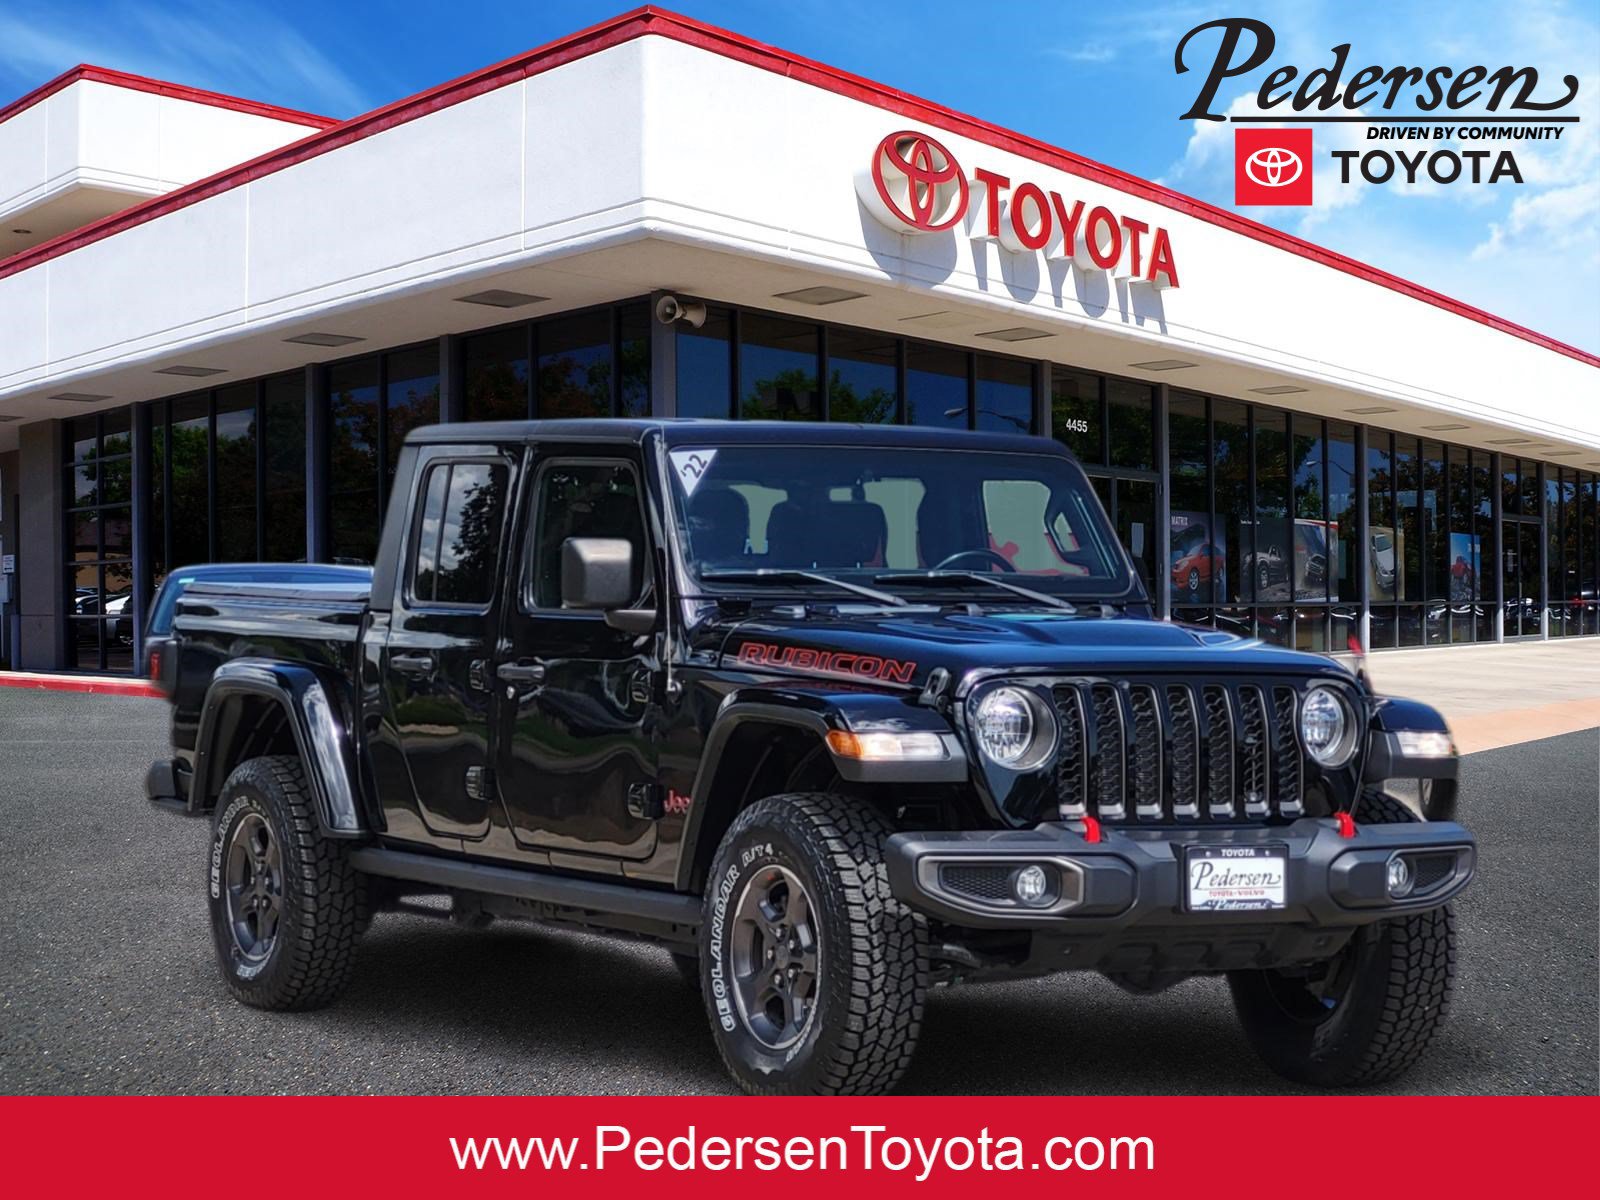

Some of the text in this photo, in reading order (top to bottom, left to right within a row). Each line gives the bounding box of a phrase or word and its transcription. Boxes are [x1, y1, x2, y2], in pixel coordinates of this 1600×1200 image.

[974, 167, 1180, 289] TOYOTA
[1066, 418, 1088, 433] 4455
[1171, 515, 1189, 527] MATRIX
[737, 642, 917, 684] RUBICON
[663, 789, 692, 814] Jee
[1221, 848, 1256, 857] TOYOTA
[1191, 861, 1282, 890] Pedersen
[710, 864, 741, 1032] GEOLANDAR
